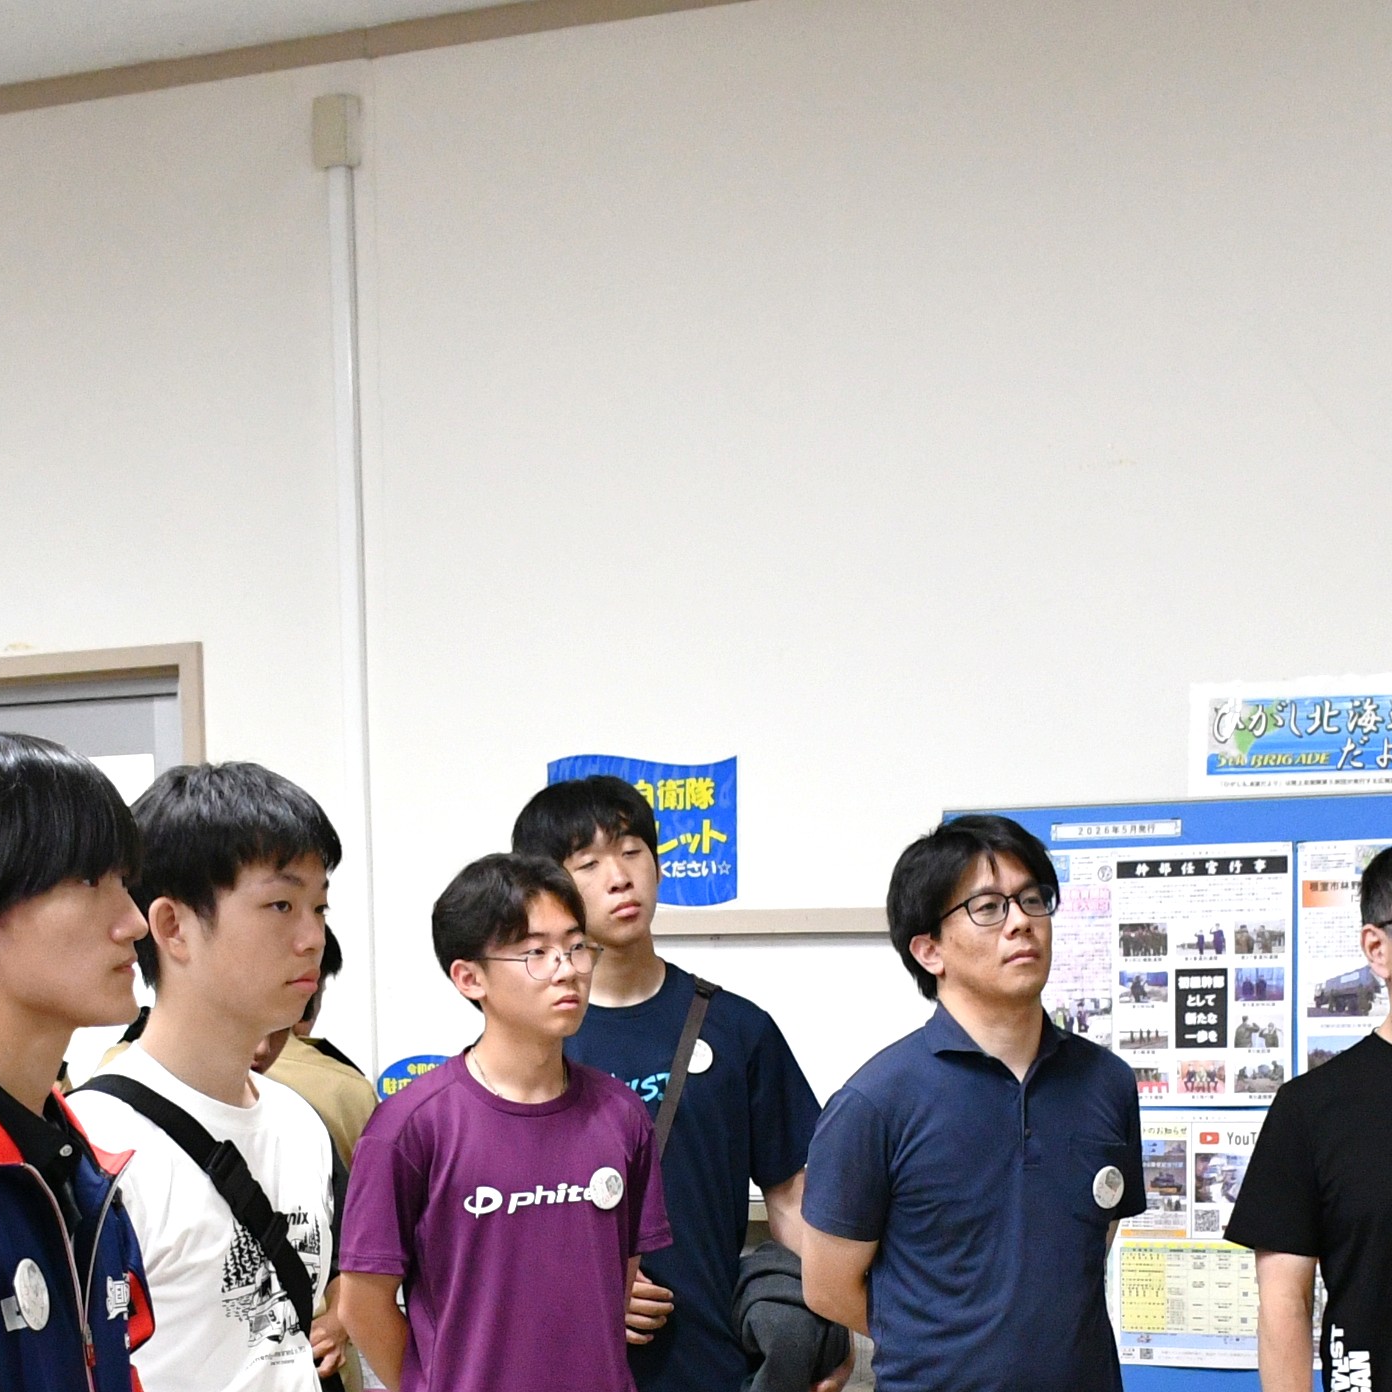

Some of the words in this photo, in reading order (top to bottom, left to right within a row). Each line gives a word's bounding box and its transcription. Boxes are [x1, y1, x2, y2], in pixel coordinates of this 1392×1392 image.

[1249, 752, 1331, 768] BRIGADE
[1077, 823, 1156, 836] 2026年5月発行
[1186, 993, 1217, 1007] として
